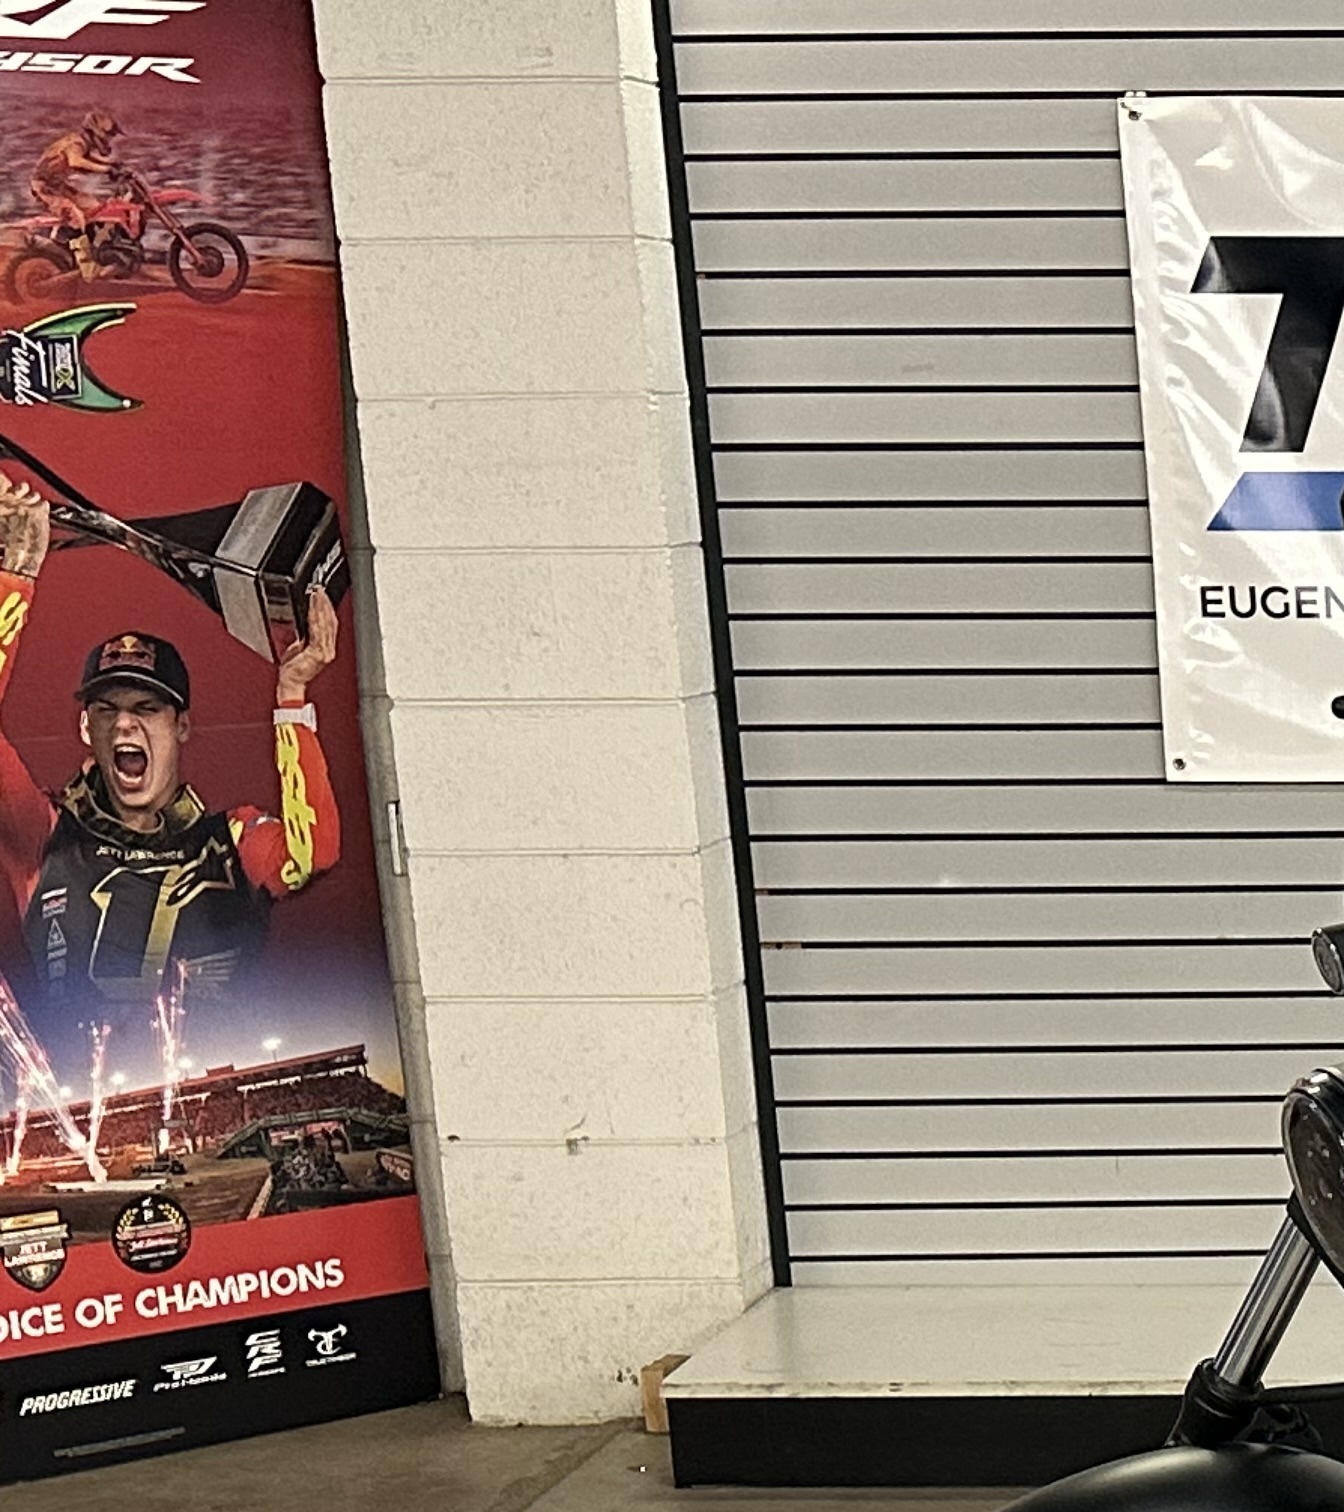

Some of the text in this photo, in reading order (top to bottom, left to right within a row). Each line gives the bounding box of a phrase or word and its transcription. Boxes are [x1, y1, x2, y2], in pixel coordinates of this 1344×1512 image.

[75, 1293, 124, 1328] OF
[134, 1257, 344, 1318] CHAMPIONS
[18, 1379, 136, 1416] PROGRESSIVE
